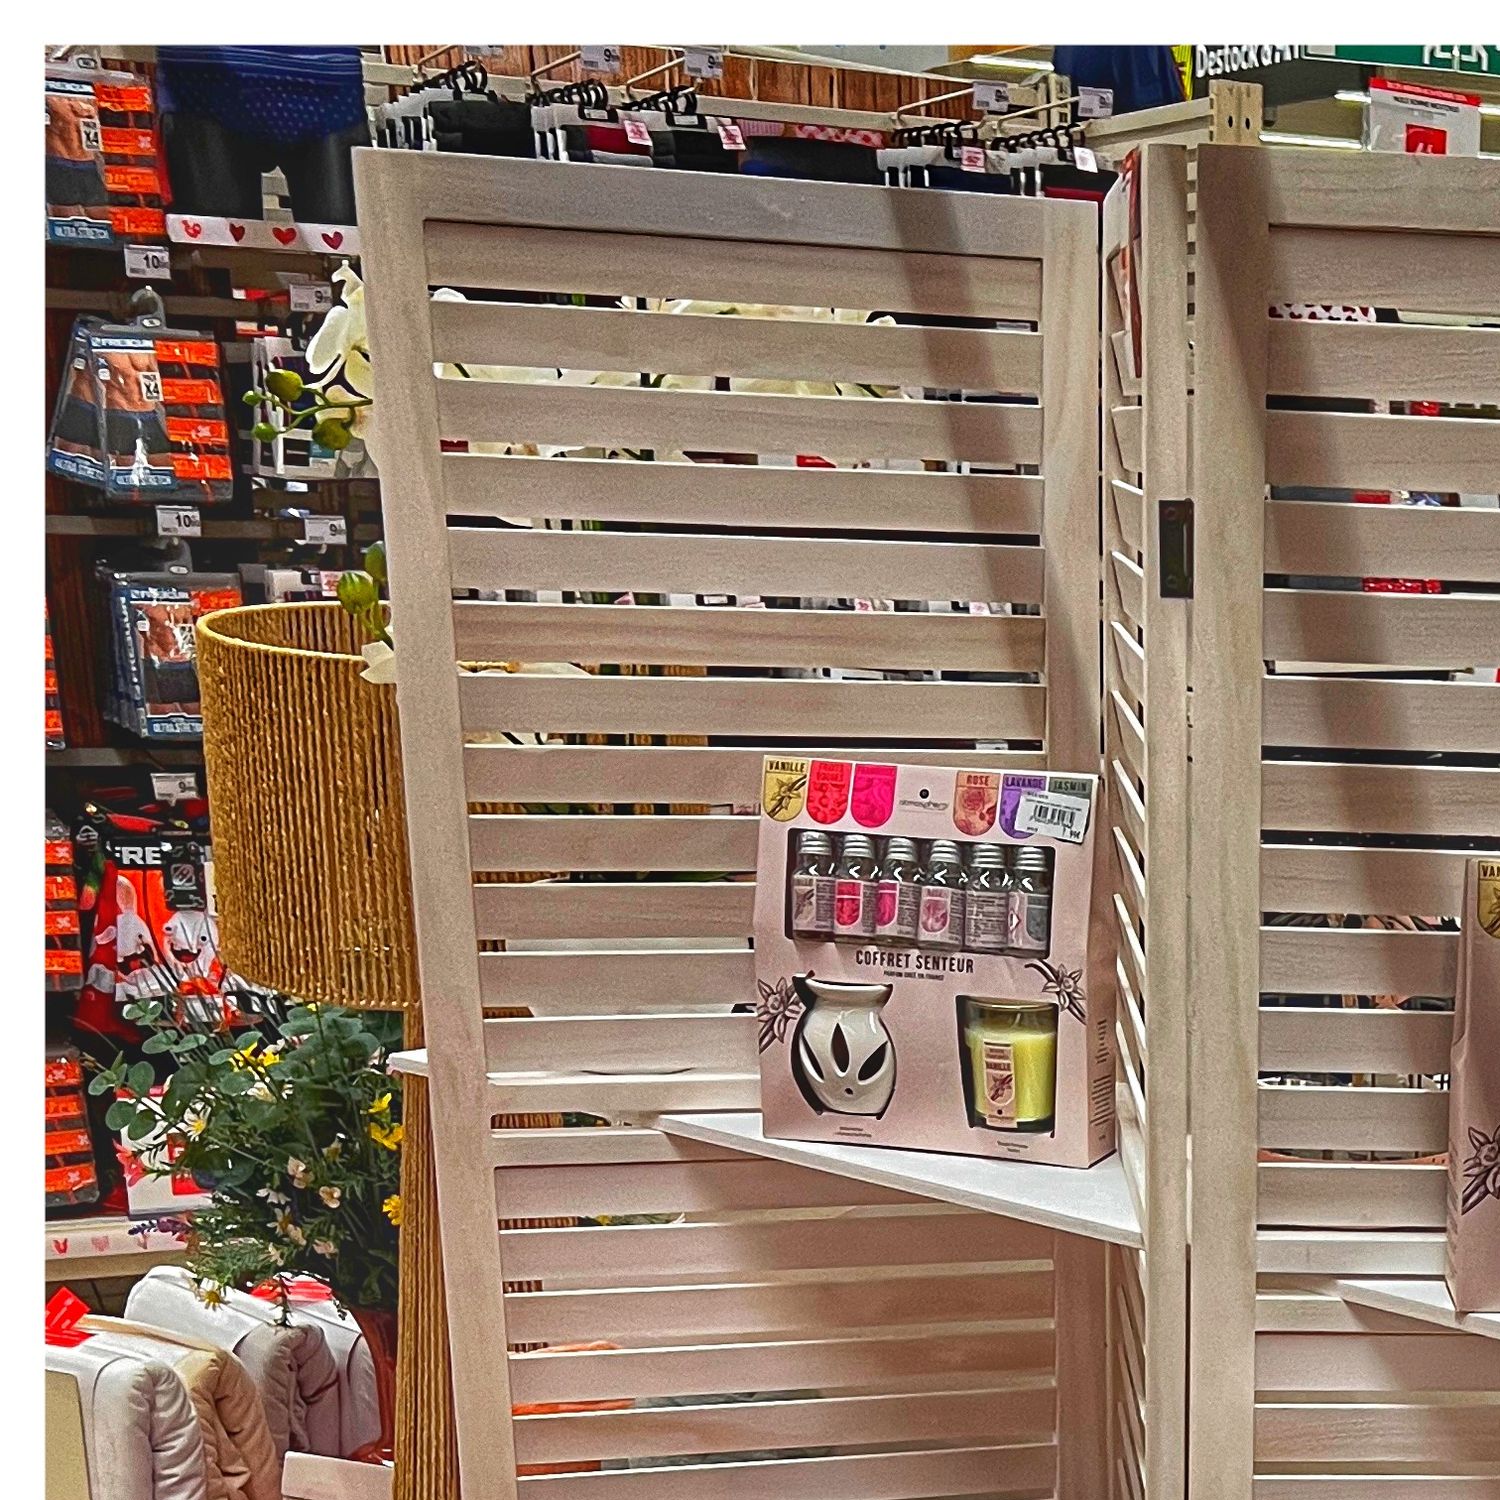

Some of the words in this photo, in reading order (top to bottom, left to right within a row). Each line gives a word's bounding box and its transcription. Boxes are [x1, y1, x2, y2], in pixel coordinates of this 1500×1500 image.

[769, 760, 806, 773] VANILLE
[966, 775, 989, 786] ROSE
[1004, 777, 1044, 790] LAVANDE
[856, 950, 910, 970] COFFRET
[916, 953, 974, 974] SENTEUR
